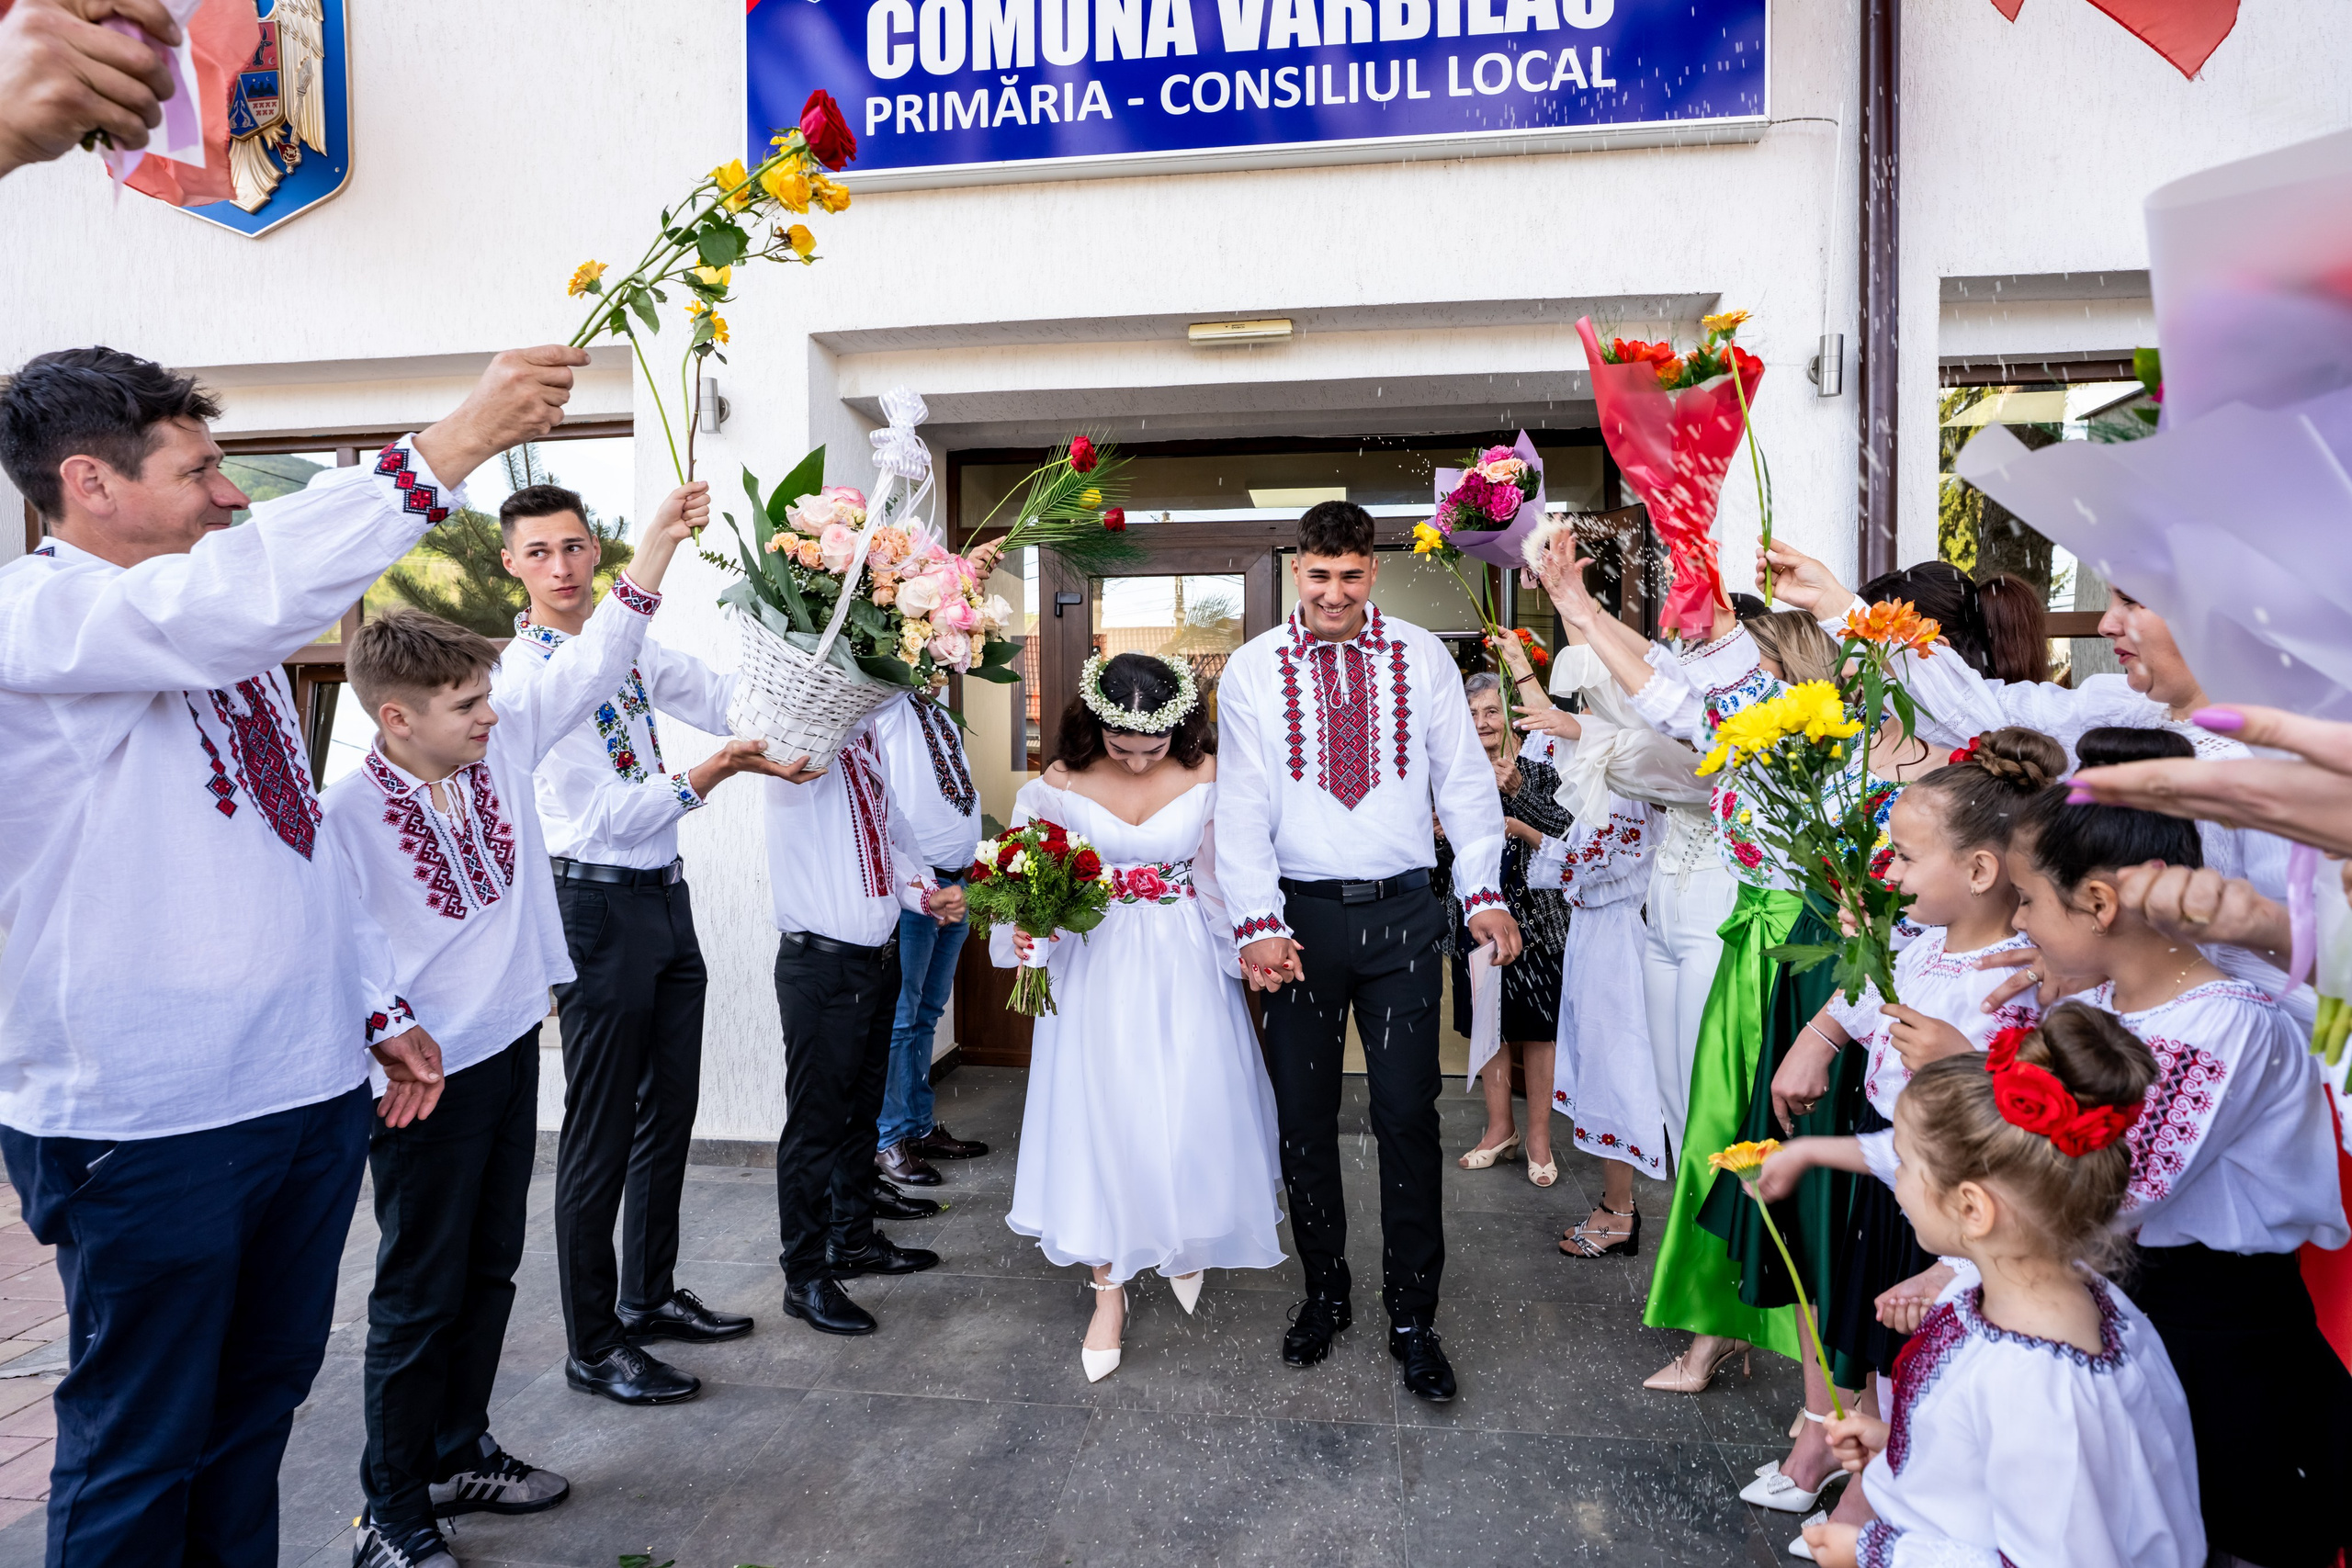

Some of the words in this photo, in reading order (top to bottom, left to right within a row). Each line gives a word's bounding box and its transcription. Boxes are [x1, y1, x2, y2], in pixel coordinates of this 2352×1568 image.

[866, 0, 1198, 80] COMUNA
[865, 74, 1114, 137] PRIMĂRIA
[1127, 97, 1145, 107] -
[1160, 58, 1431, 116] CONSILIUL
[1448, 46, 1617, 97] LOCAL
